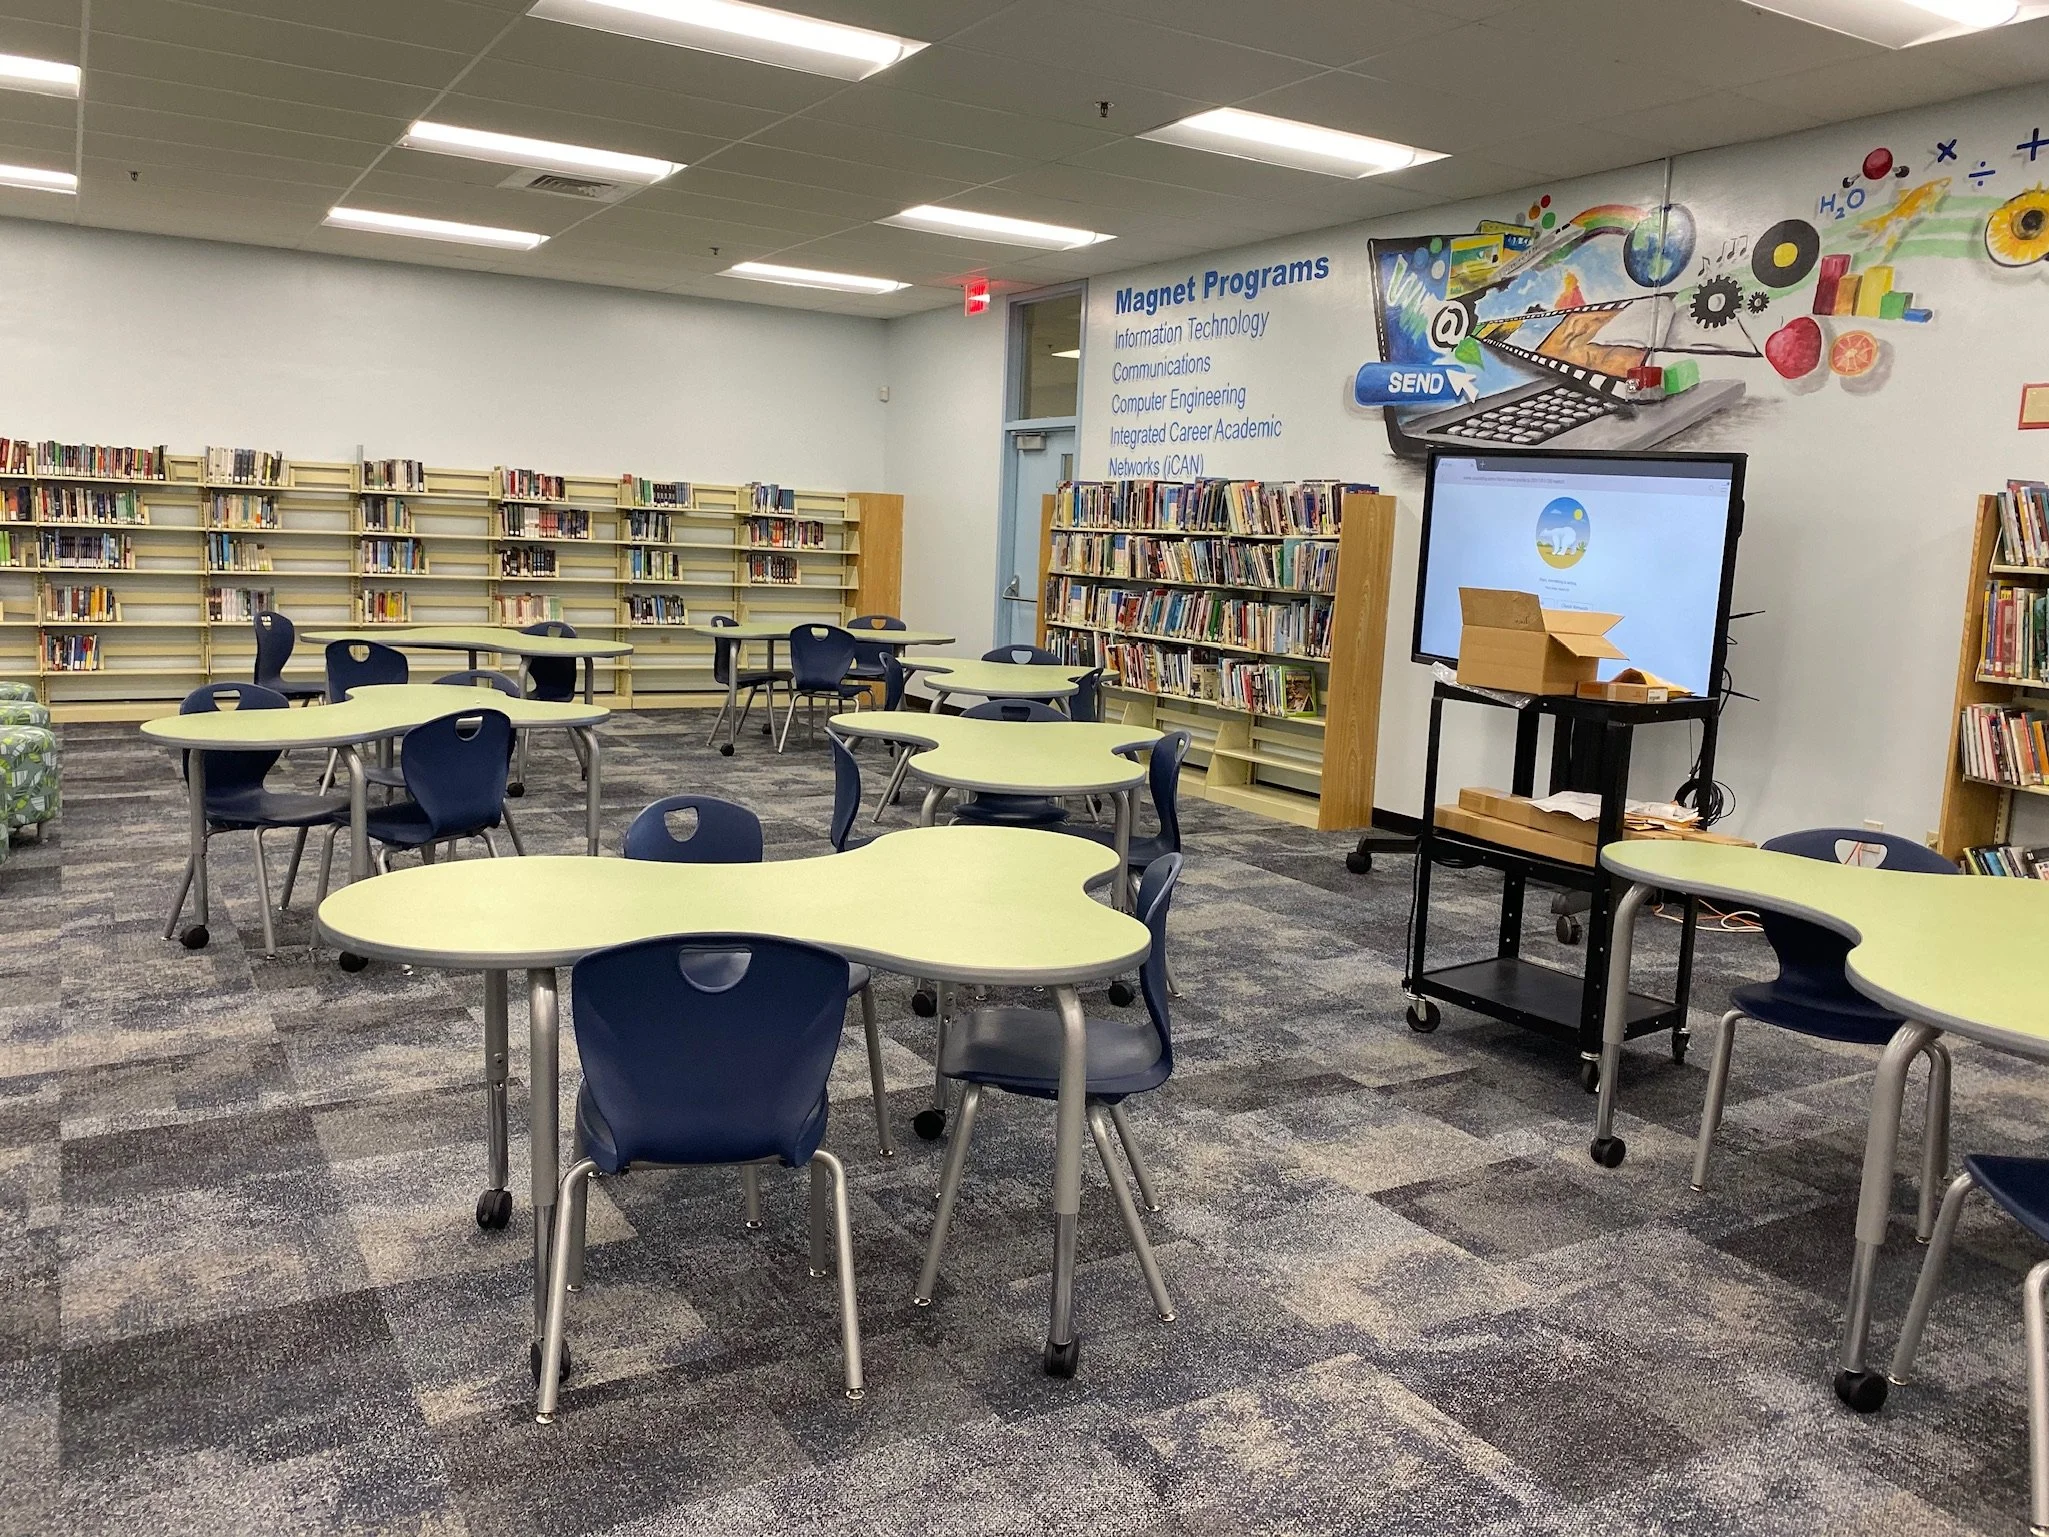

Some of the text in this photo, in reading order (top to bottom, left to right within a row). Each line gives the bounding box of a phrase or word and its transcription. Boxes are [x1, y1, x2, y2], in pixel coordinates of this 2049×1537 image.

[1115, 256, 1330, 315] Magnet Programs
[1114, 310, 1270, 350] Information Technology
[1112, 353, 1211, 383] Communications
[1388, 372, 1445, 395] SEND
[1111, 383, 1247, 418] Computer Engineering
[1110, 414, 1283, 450] Integrated Career Academic
[1108, 454, 1204, 480] Networks (iCAN)
